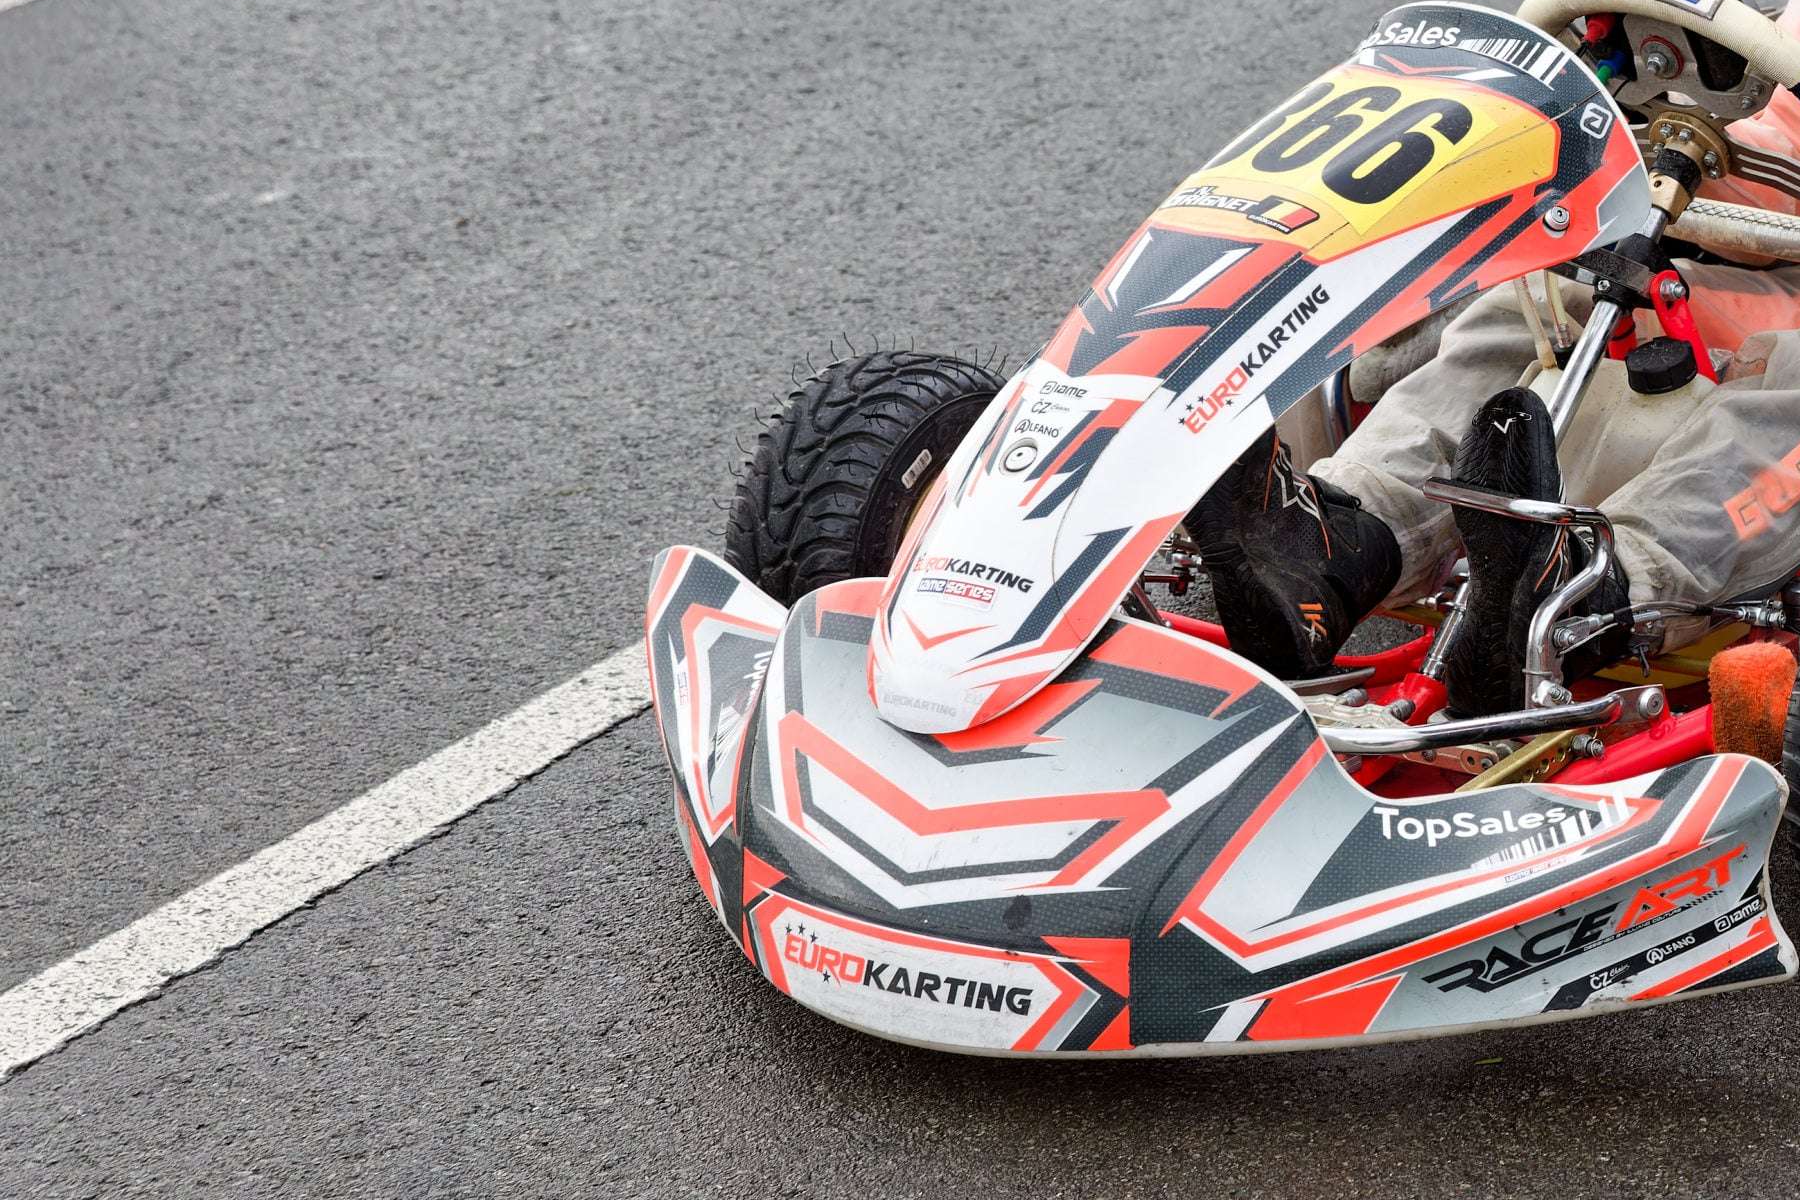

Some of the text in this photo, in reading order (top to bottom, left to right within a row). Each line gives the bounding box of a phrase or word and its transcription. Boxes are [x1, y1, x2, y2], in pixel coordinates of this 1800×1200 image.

[1183, 283, 1331, 434] EUROKARTING
[1015, 419, 1060, 438] ALFANO
[912, 555, 1035, 594] EUROKARTING
[1372, 806, 1567, 847] TopSales
[1645, 933, 1697, 965] ALFANO
[783, 932, 1034, 1017] EUROKARTING
